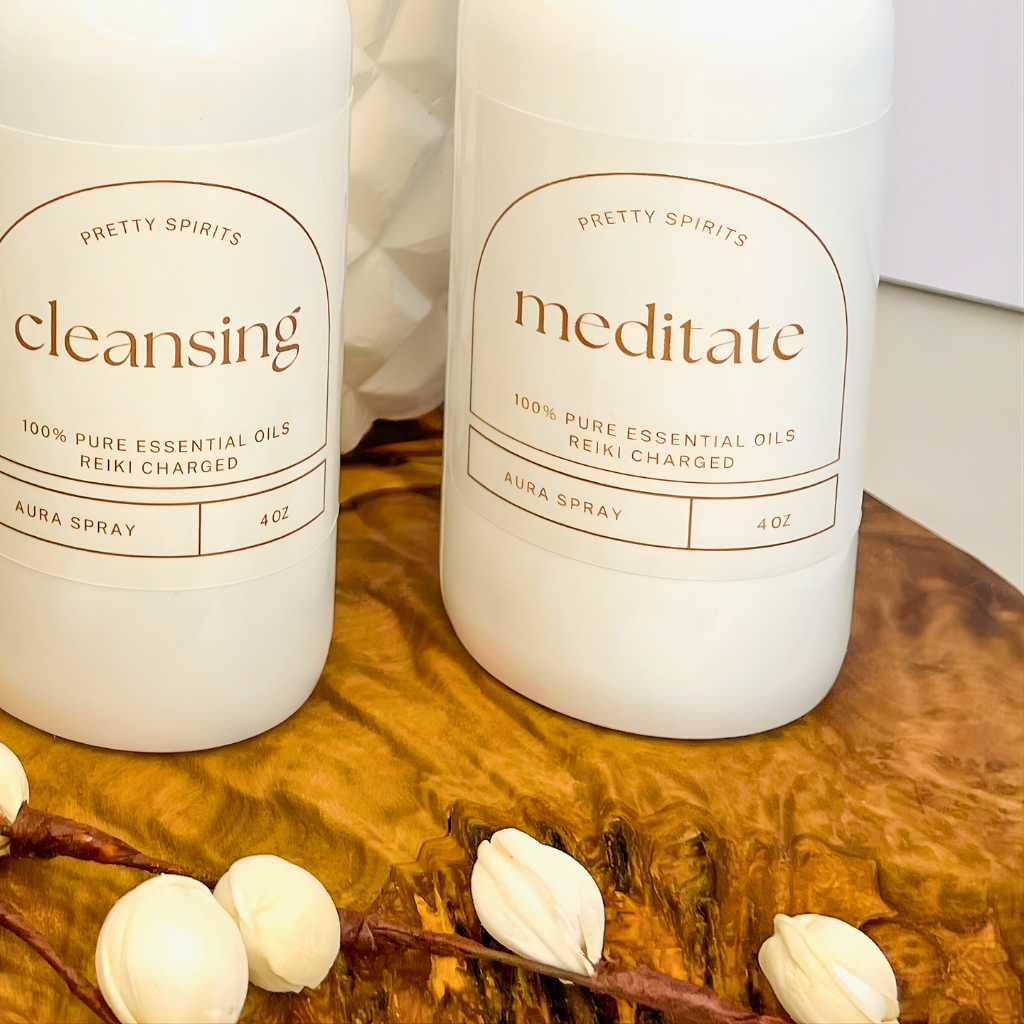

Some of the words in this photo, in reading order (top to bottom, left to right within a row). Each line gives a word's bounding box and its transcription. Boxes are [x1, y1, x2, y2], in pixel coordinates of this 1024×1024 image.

[79, 217, 156, 246] PRETTY
[164, 217, 243, 247] SPIRITS
[577, 209, 656, 232] PRETTY
[664, 211, 749, 248] SPIRITS
[13, 299, 302, 373] cleansing
[514, 290, 805, 365] meditate
[22, 418, 68, 443] 100%
[75, 432, 128, 453] PURE
[136, 433, 247, 454] ESSENTIAL
[253, 421, 291, 445] OILS
[513, 392, 557, 421] 100%
[564, 412, 618, 438] PURE
[626, 426, 746, 449] ESSENTIAL
[753, 428, 796, 447] OILS
[79, 454, 133, 475] REIKI
[141, 456, 239, 476] CHARGED
[568, 434, 622, 460] REIKI
[630, 448, 736, 470] CHARGED
[503, 471, 550, 502] AURA
[556, 492, 623, 522] SPRAY
[14, 499, 63, 527] AURA
[69, 515, 136, 538] SPRAY
